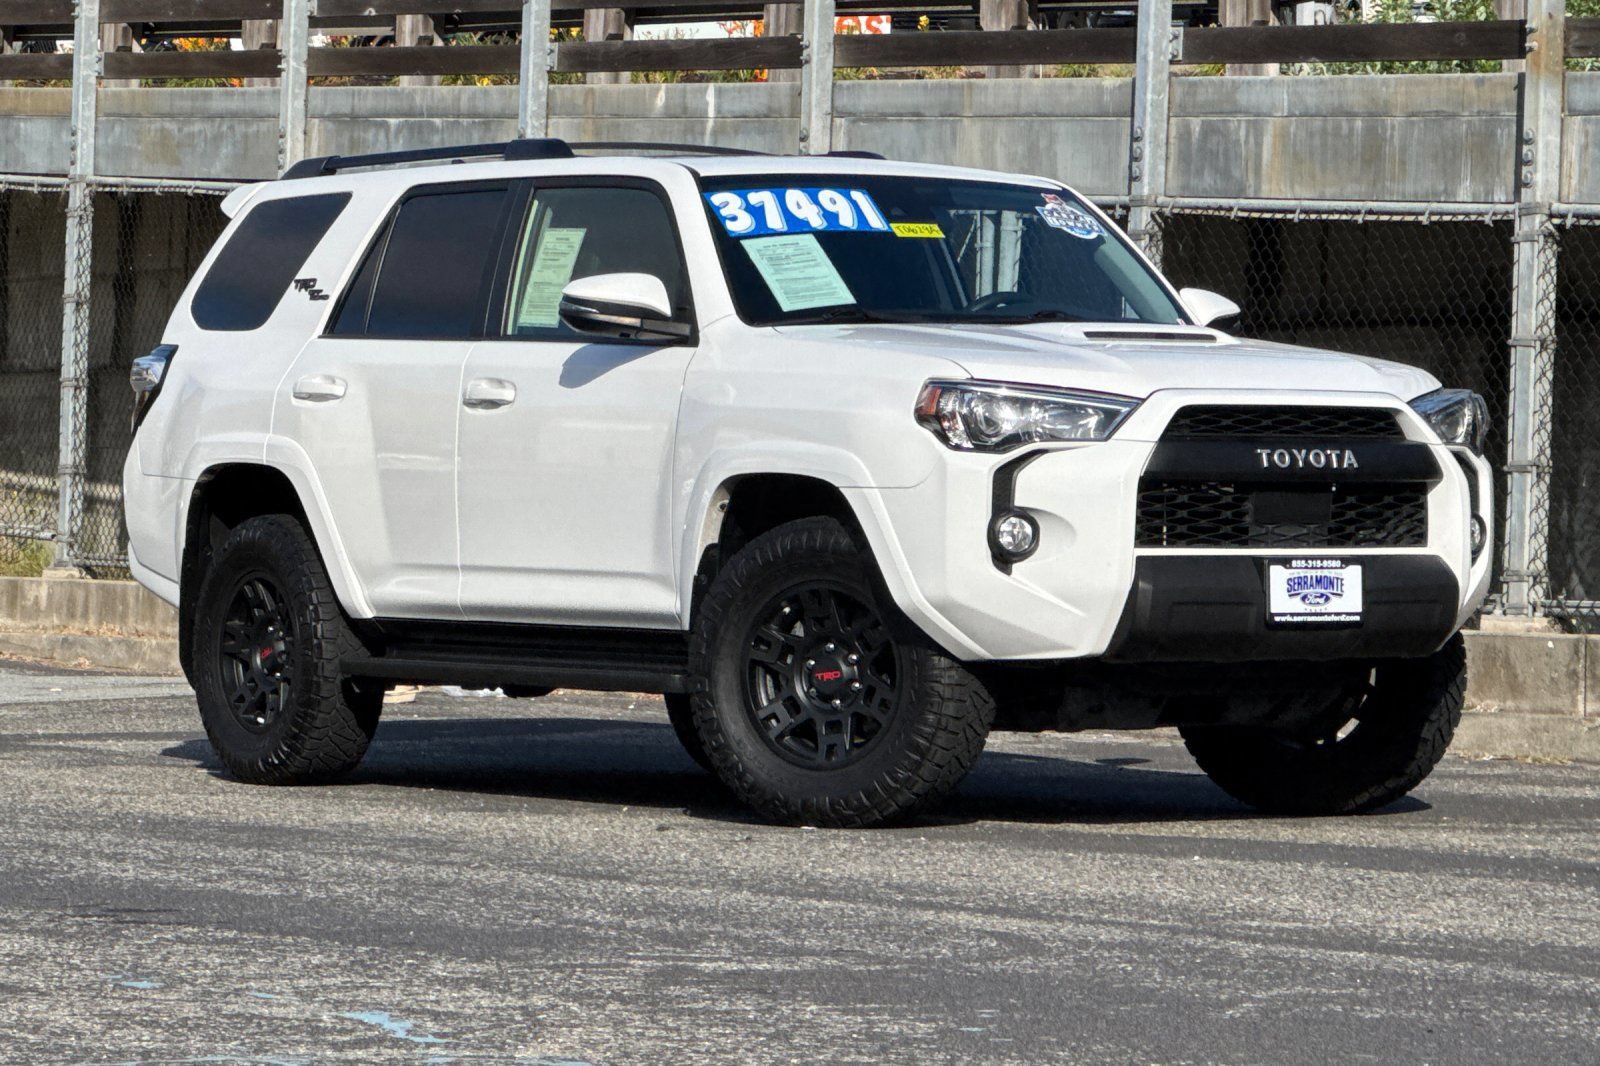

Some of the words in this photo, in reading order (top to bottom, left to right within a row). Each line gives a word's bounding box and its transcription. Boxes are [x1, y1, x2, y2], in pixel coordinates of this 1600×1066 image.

[710, 188, 888, 233] 37491
[1256, 448, 1359, 469] TOYOTA
[1286, 575, 1345, 593] SERRAMONTE
[815, 671, 841, 682] TRD
